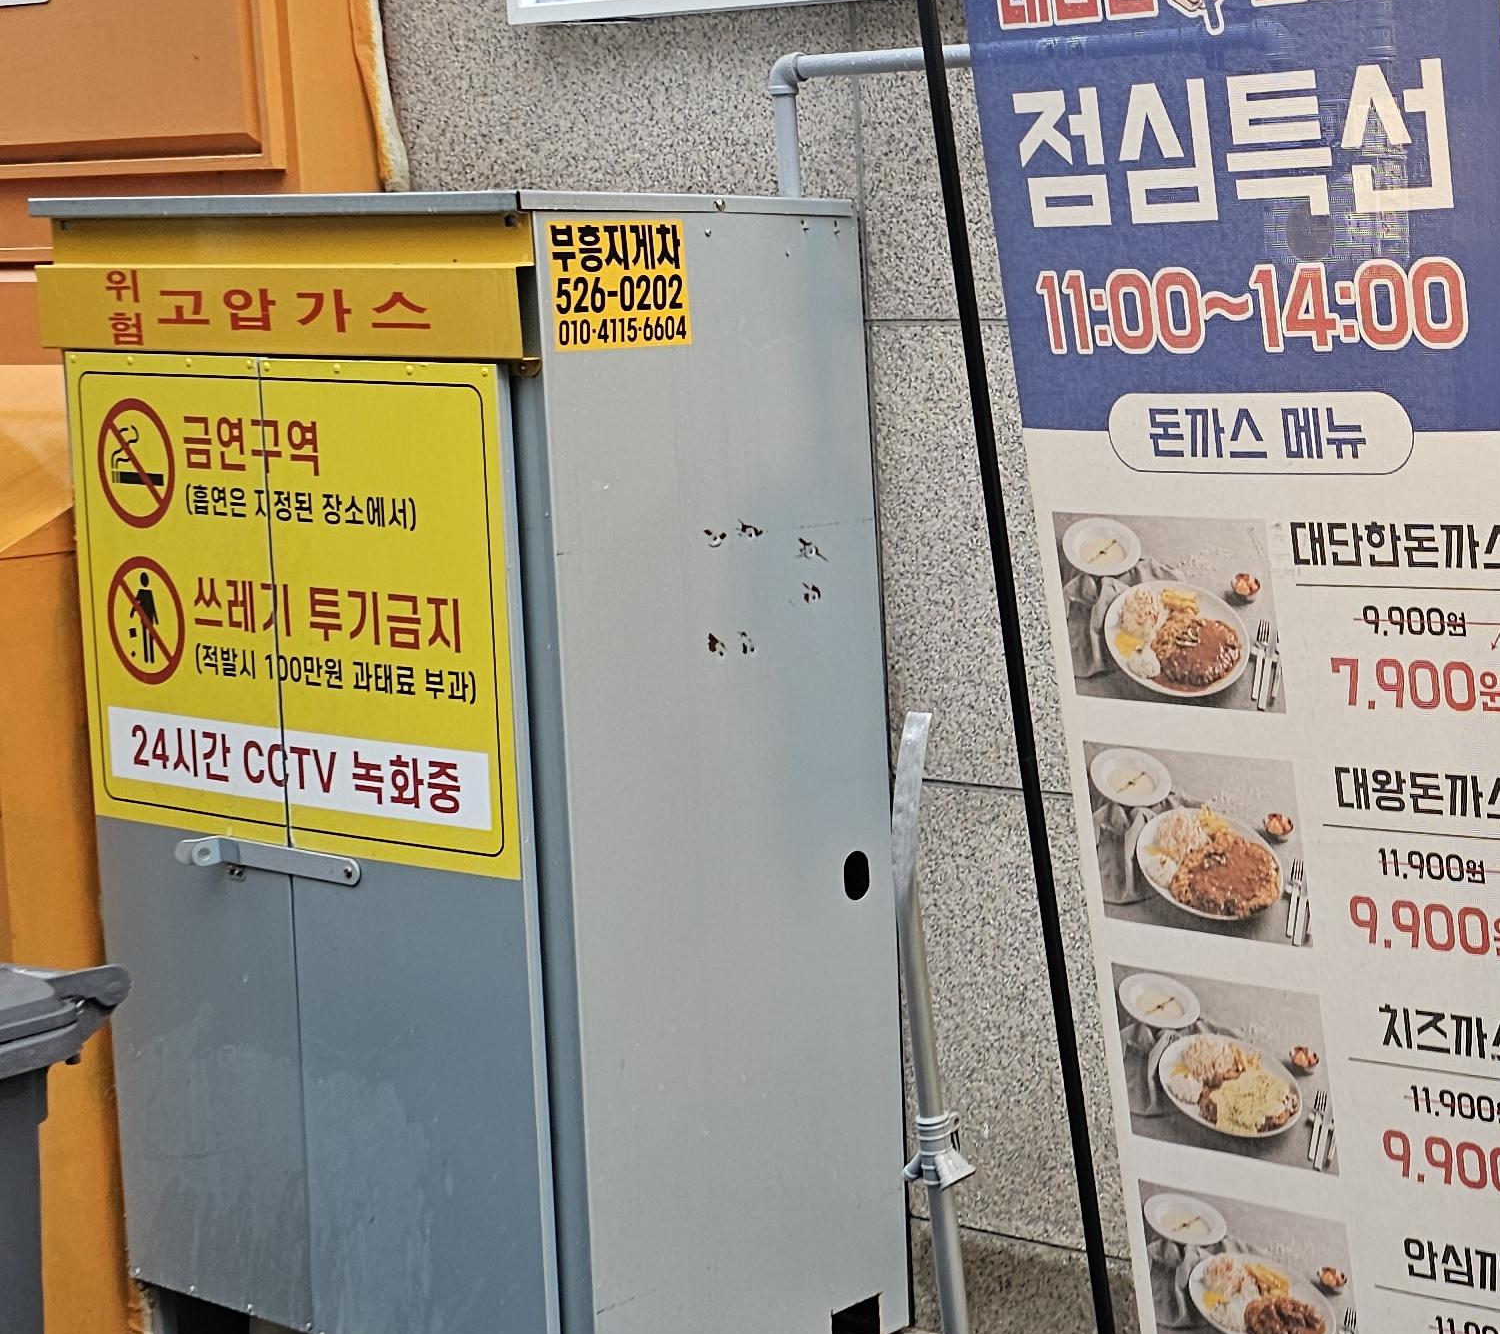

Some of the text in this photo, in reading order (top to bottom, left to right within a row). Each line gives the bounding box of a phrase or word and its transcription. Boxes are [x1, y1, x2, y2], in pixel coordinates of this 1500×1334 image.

[1012, 58, 1454, 229] 점심특선
[550, 224, 680, 272] 부흥지게차
[556, 274, 683, 314] 526-0202
[1036, 256, 1469, 355] 11:00~14:00
[183, 415, 320, 476] 금연구역
[1148, 407, 1367, 460] 돈까스 메뉴
[186, 484, 416, 531] (흡연은 지정된 장소에서)
[193, 576, 462, 654] 쓰레기 투기금지
[1361, 605, 1467, 638] 9.900원
[195, 642, 476, 705] (적발시 100만원 과태료 부과)
[131, 723, 461, 814] 24시간 CCTV 녹화중
[1377, 847, 1486, 885] 11.900원
